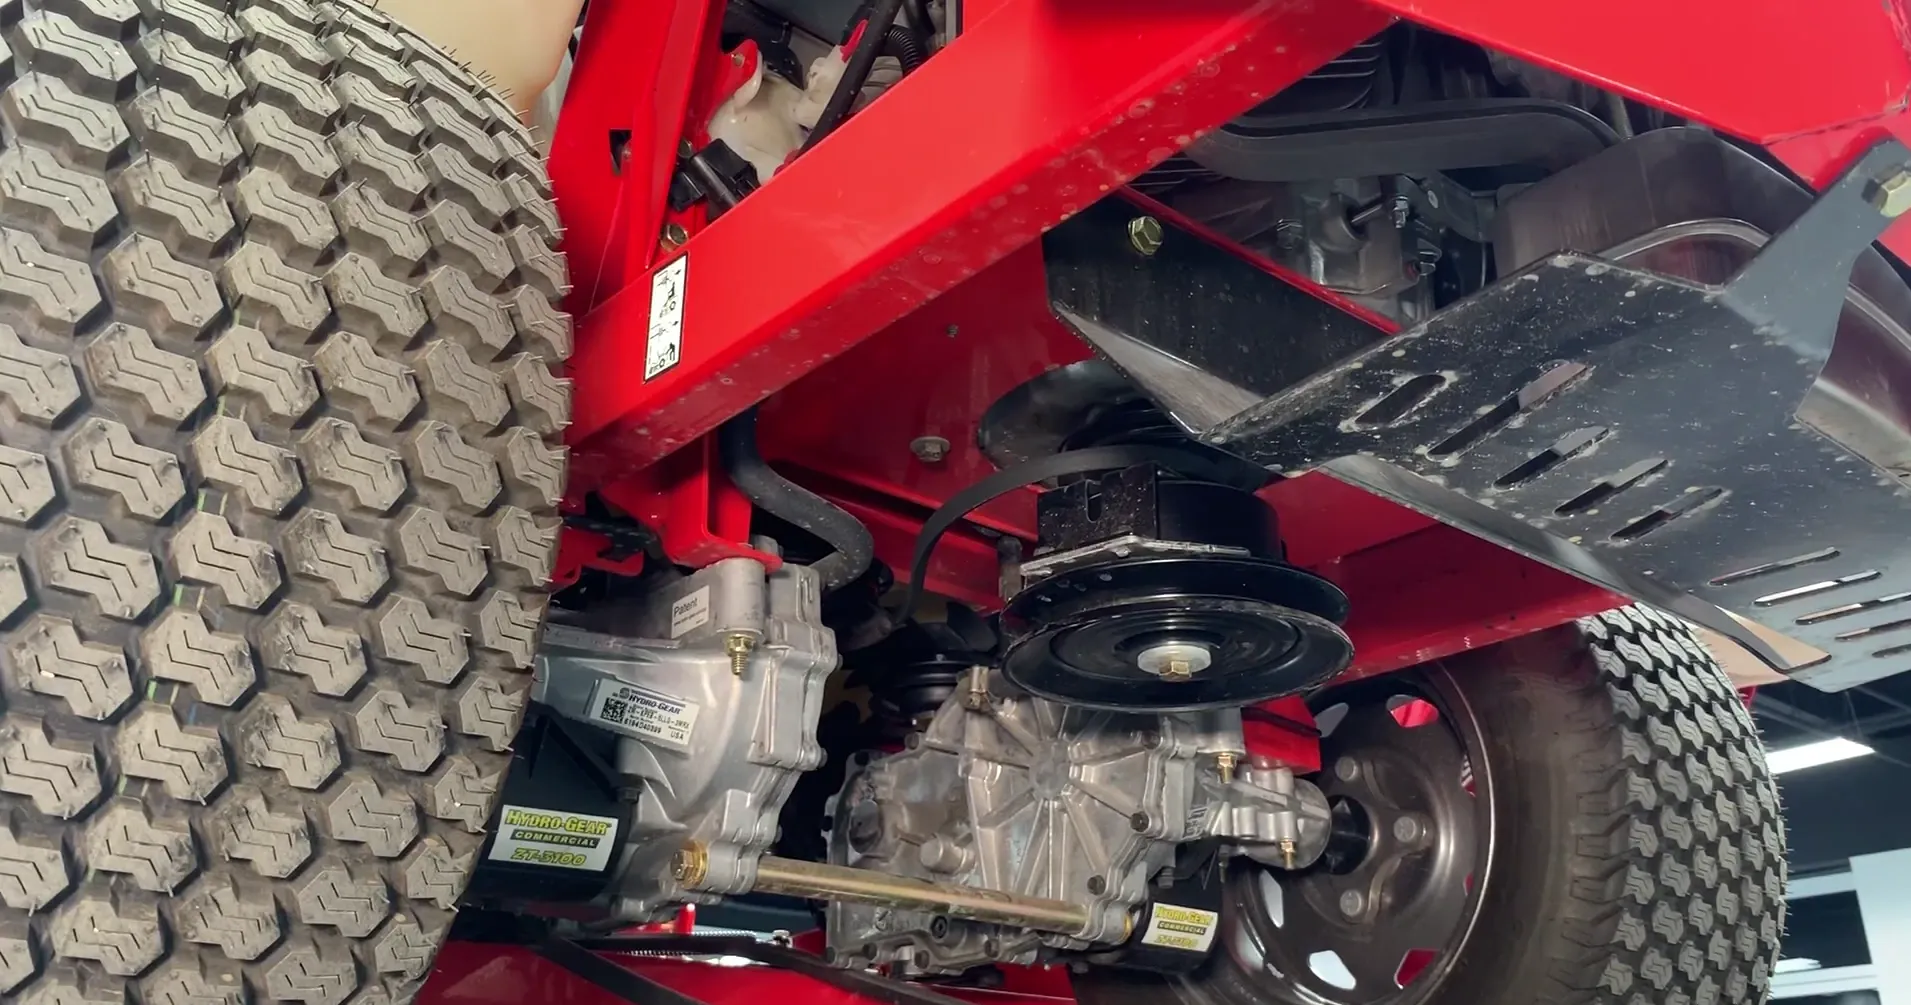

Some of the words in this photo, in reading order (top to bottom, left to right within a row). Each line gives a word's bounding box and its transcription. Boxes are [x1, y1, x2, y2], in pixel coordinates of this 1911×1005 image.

[674, 598, 698, 617] Patent
[670, 730, 684, 740] USA
[505, 809, 610, 836] HYDRO-GEAR
[515, 831, 596, 847] COMMERCIAL
[510, 847, 587, 866] ZT-3100
